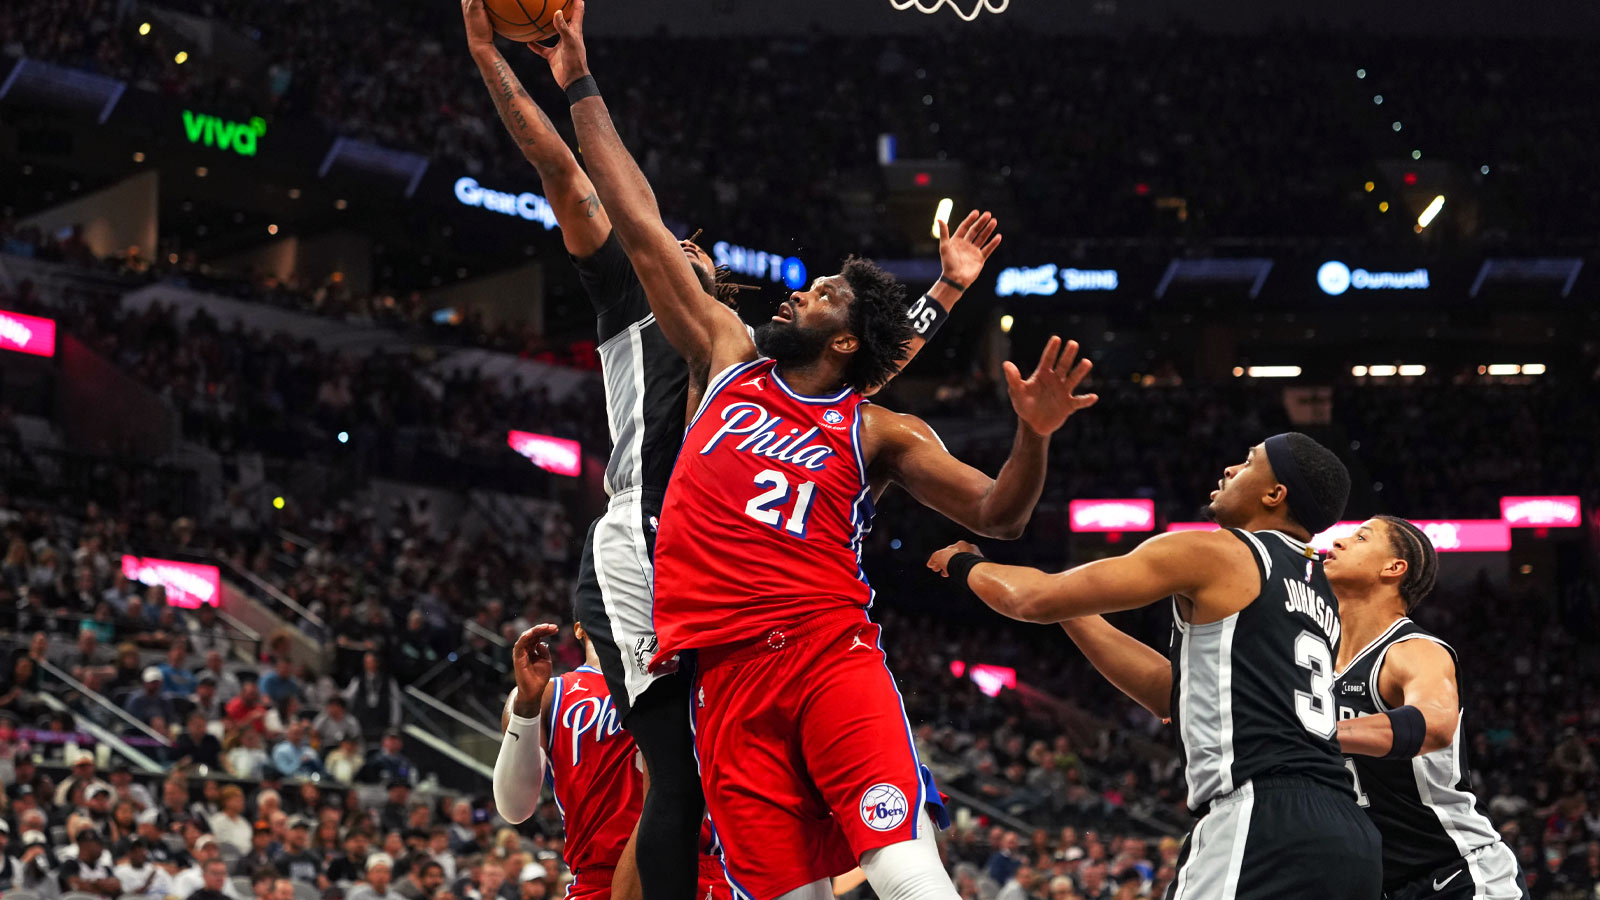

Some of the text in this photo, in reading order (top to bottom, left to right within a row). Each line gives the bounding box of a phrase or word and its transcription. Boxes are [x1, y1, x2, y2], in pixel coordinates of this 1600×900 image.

[700, 402, 836, 471] Phila
[745, 469, 818, 540] 21
[1283, 577, 1340, 650] JOHNSON
[1294, 629, 1337, 740] 3
[563, 694, 624, 767] Ph
[865, 802, 904, 821] 76ers
